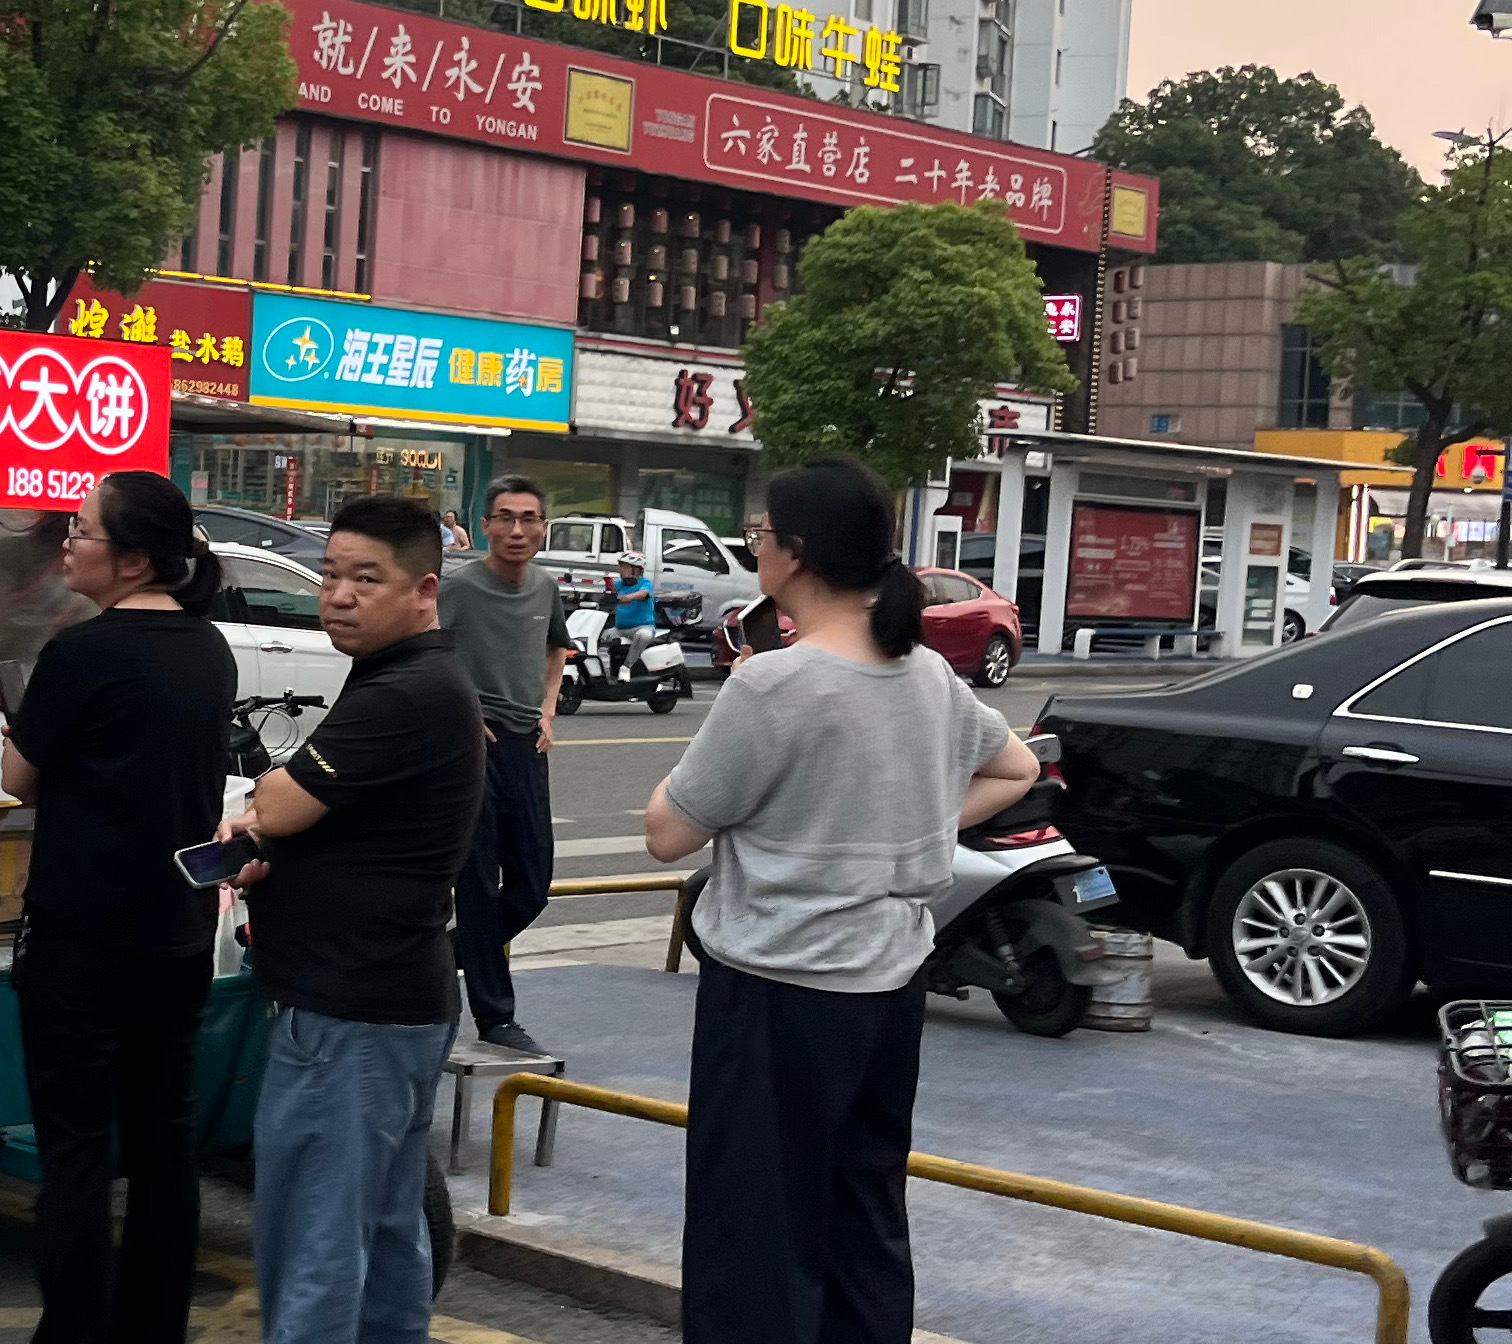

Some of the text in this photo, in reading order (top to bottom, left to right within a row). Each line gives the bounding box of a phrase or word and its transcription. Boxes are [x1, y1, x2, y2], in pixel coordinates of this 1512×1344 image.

[297, 82, 539, 142] AND COME TO YONGAN
[720, 113, 871, 184] 六家直营店
[894, 157, 1053, 222] 二十年老品牌
[171, 378, 240, 396] 862982448
[335, 328, 564, 397] 海王星辰 健康药房
[7, 467, 43, 498] 188
[46, 470, 110, 500] 5123
